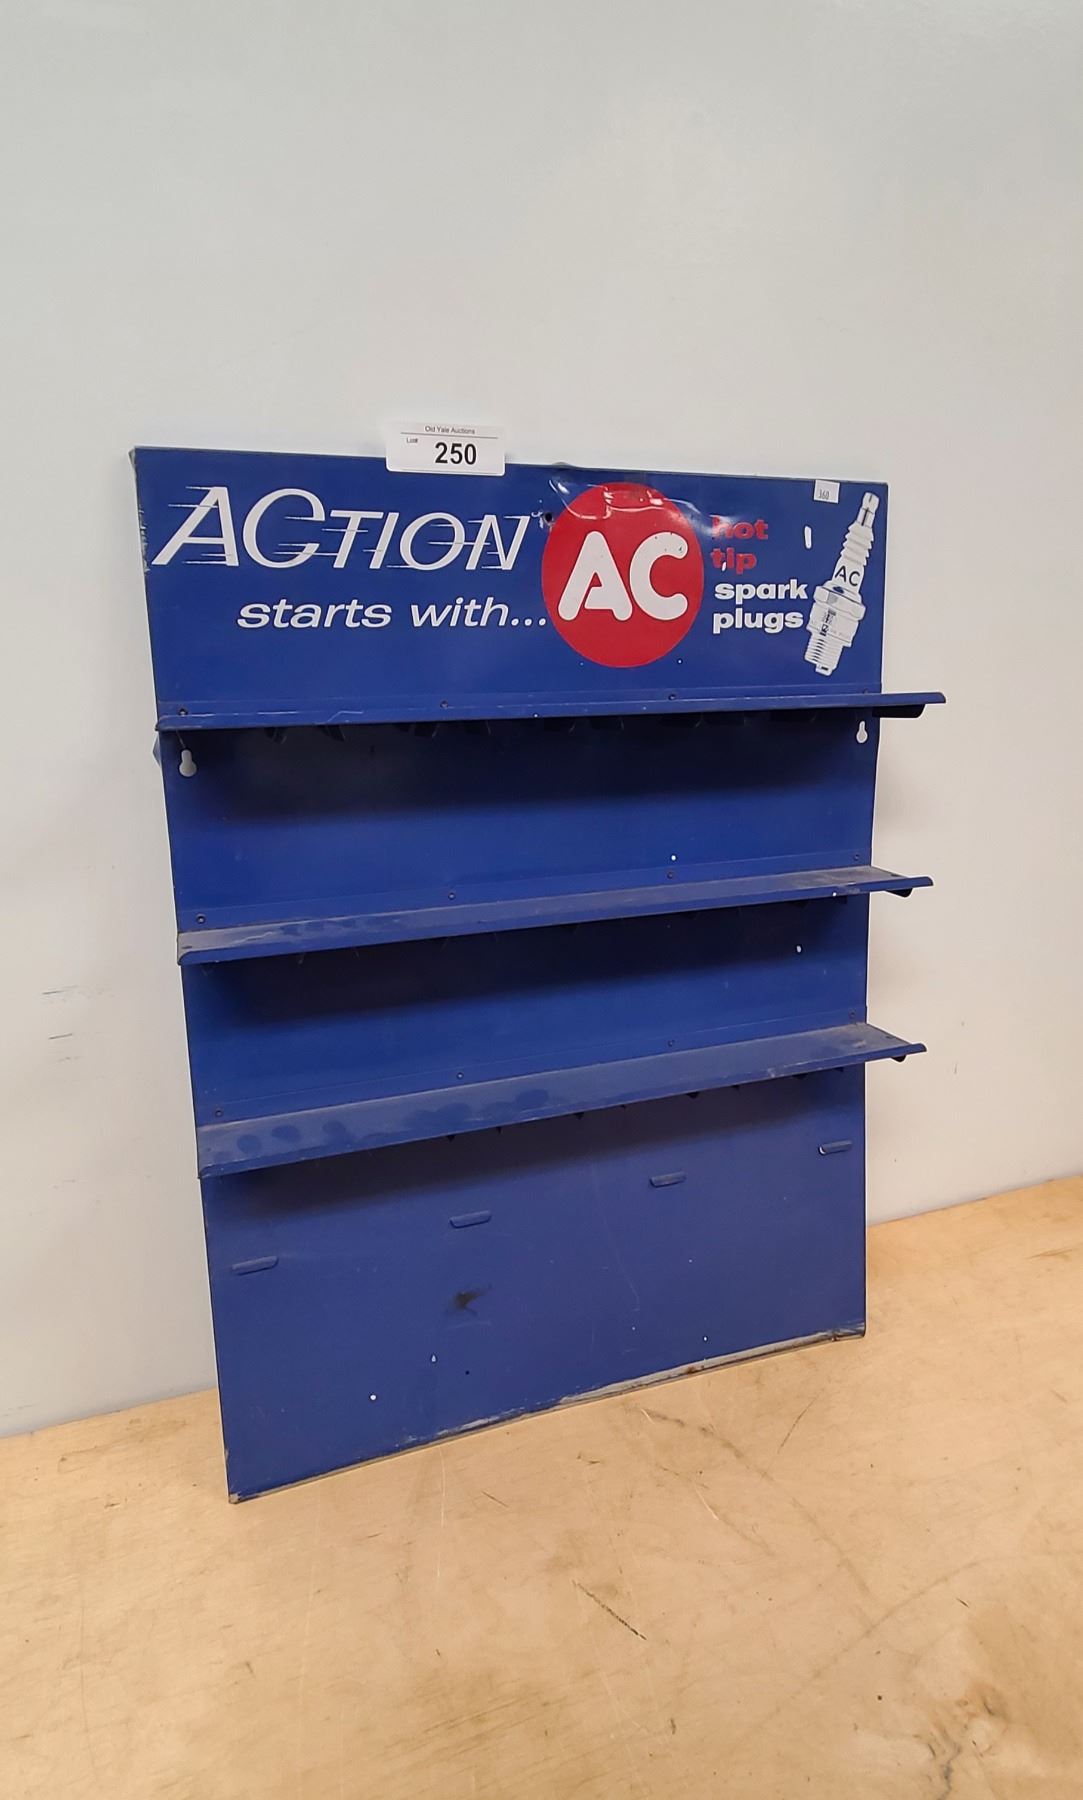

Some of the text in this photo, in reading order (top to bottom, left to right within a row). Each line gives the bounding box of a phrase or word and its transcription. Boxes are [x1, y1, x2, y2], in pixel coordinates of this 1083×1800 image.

[425, 425, 475, 435] Old Yale Auctions
[435, 441, 477, 465] 250
[152, 486, 531, 570] ACTION
[711, 515, 769, 540] hot
[710, 547, 757, 575] tip
[558, 531, 688, 621] AC
[834, 565, 861, 587] AC
[714, 579, 808, 605] spark
[237, 597, 547, 628] starts with...
[712, 608, 804, 634] plugs
